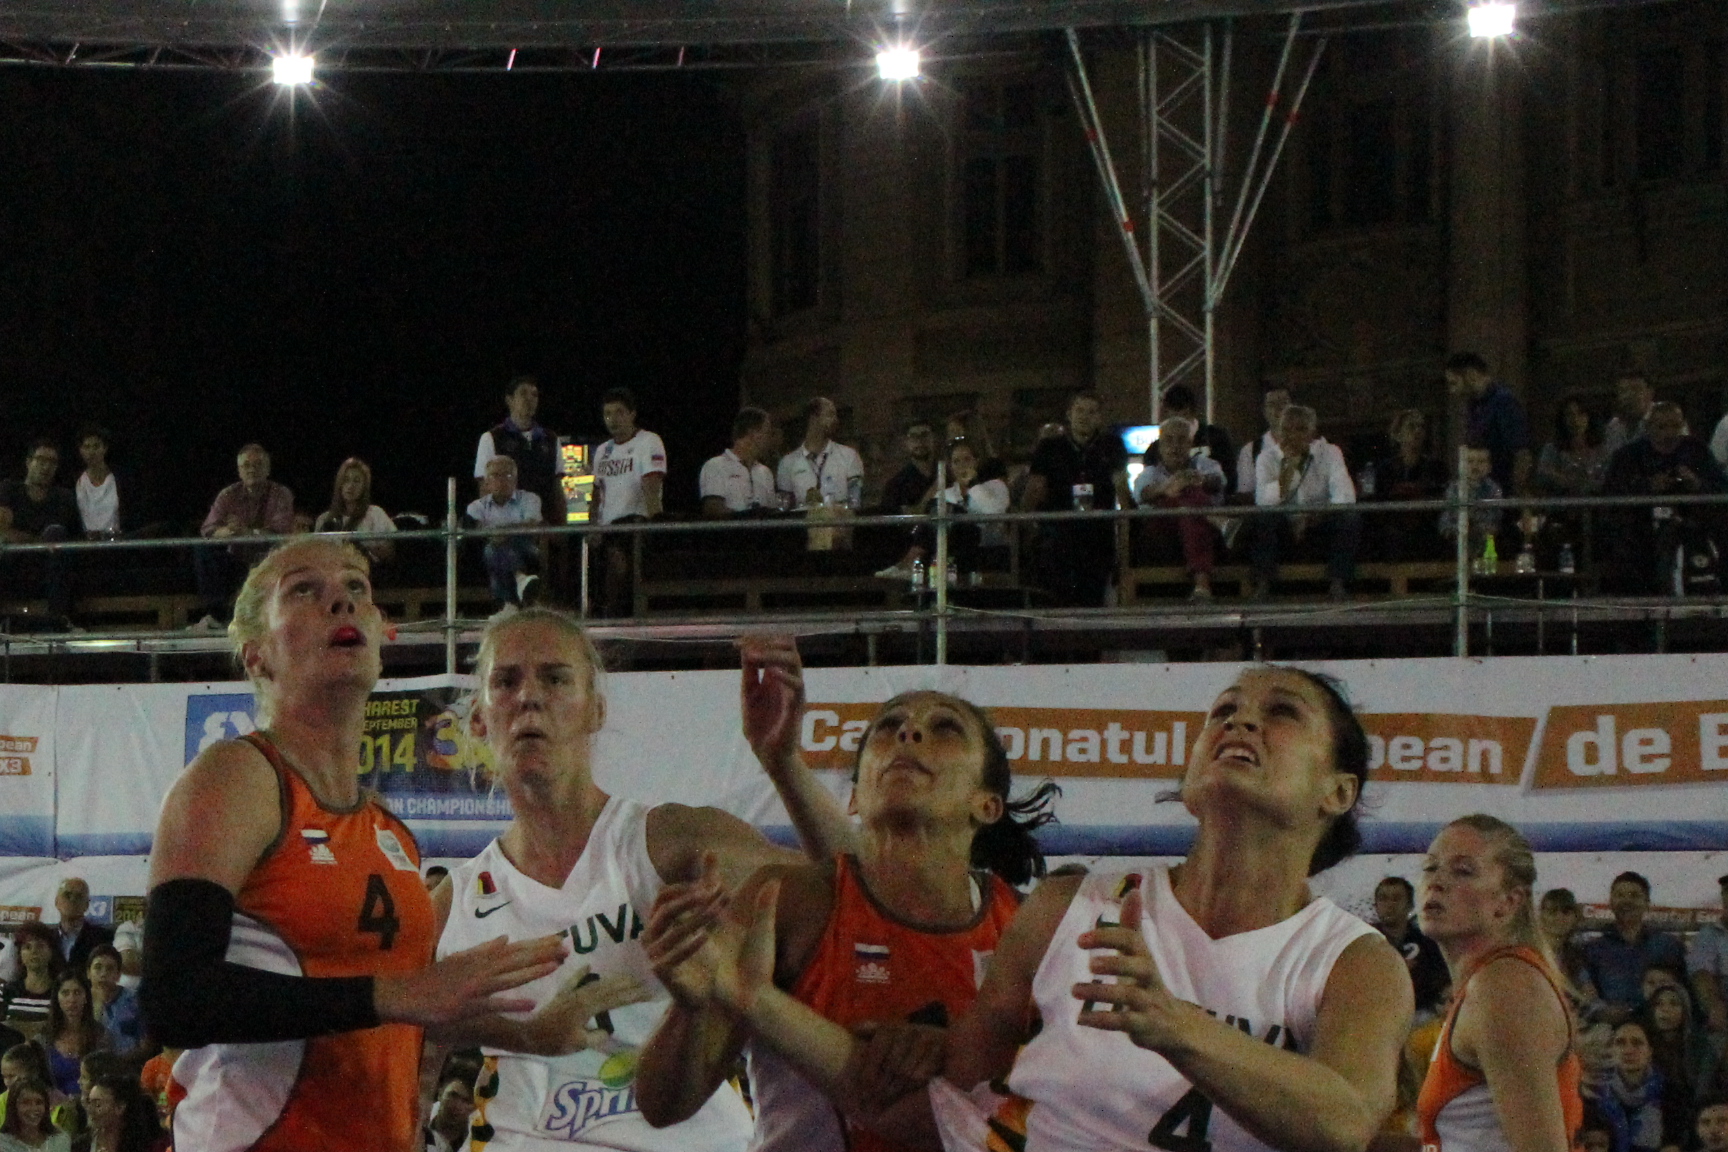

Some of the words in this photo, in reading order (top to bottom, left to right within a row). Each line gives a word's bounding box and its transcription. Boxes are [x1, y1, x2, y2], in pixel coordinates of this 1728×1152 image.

[358, 732, 416, 774] 014
[1566, 714, 1673, 776] de
[406, 797, 514, 816] CHAMPIONSHI
[357, 873, 401, 951] 4
